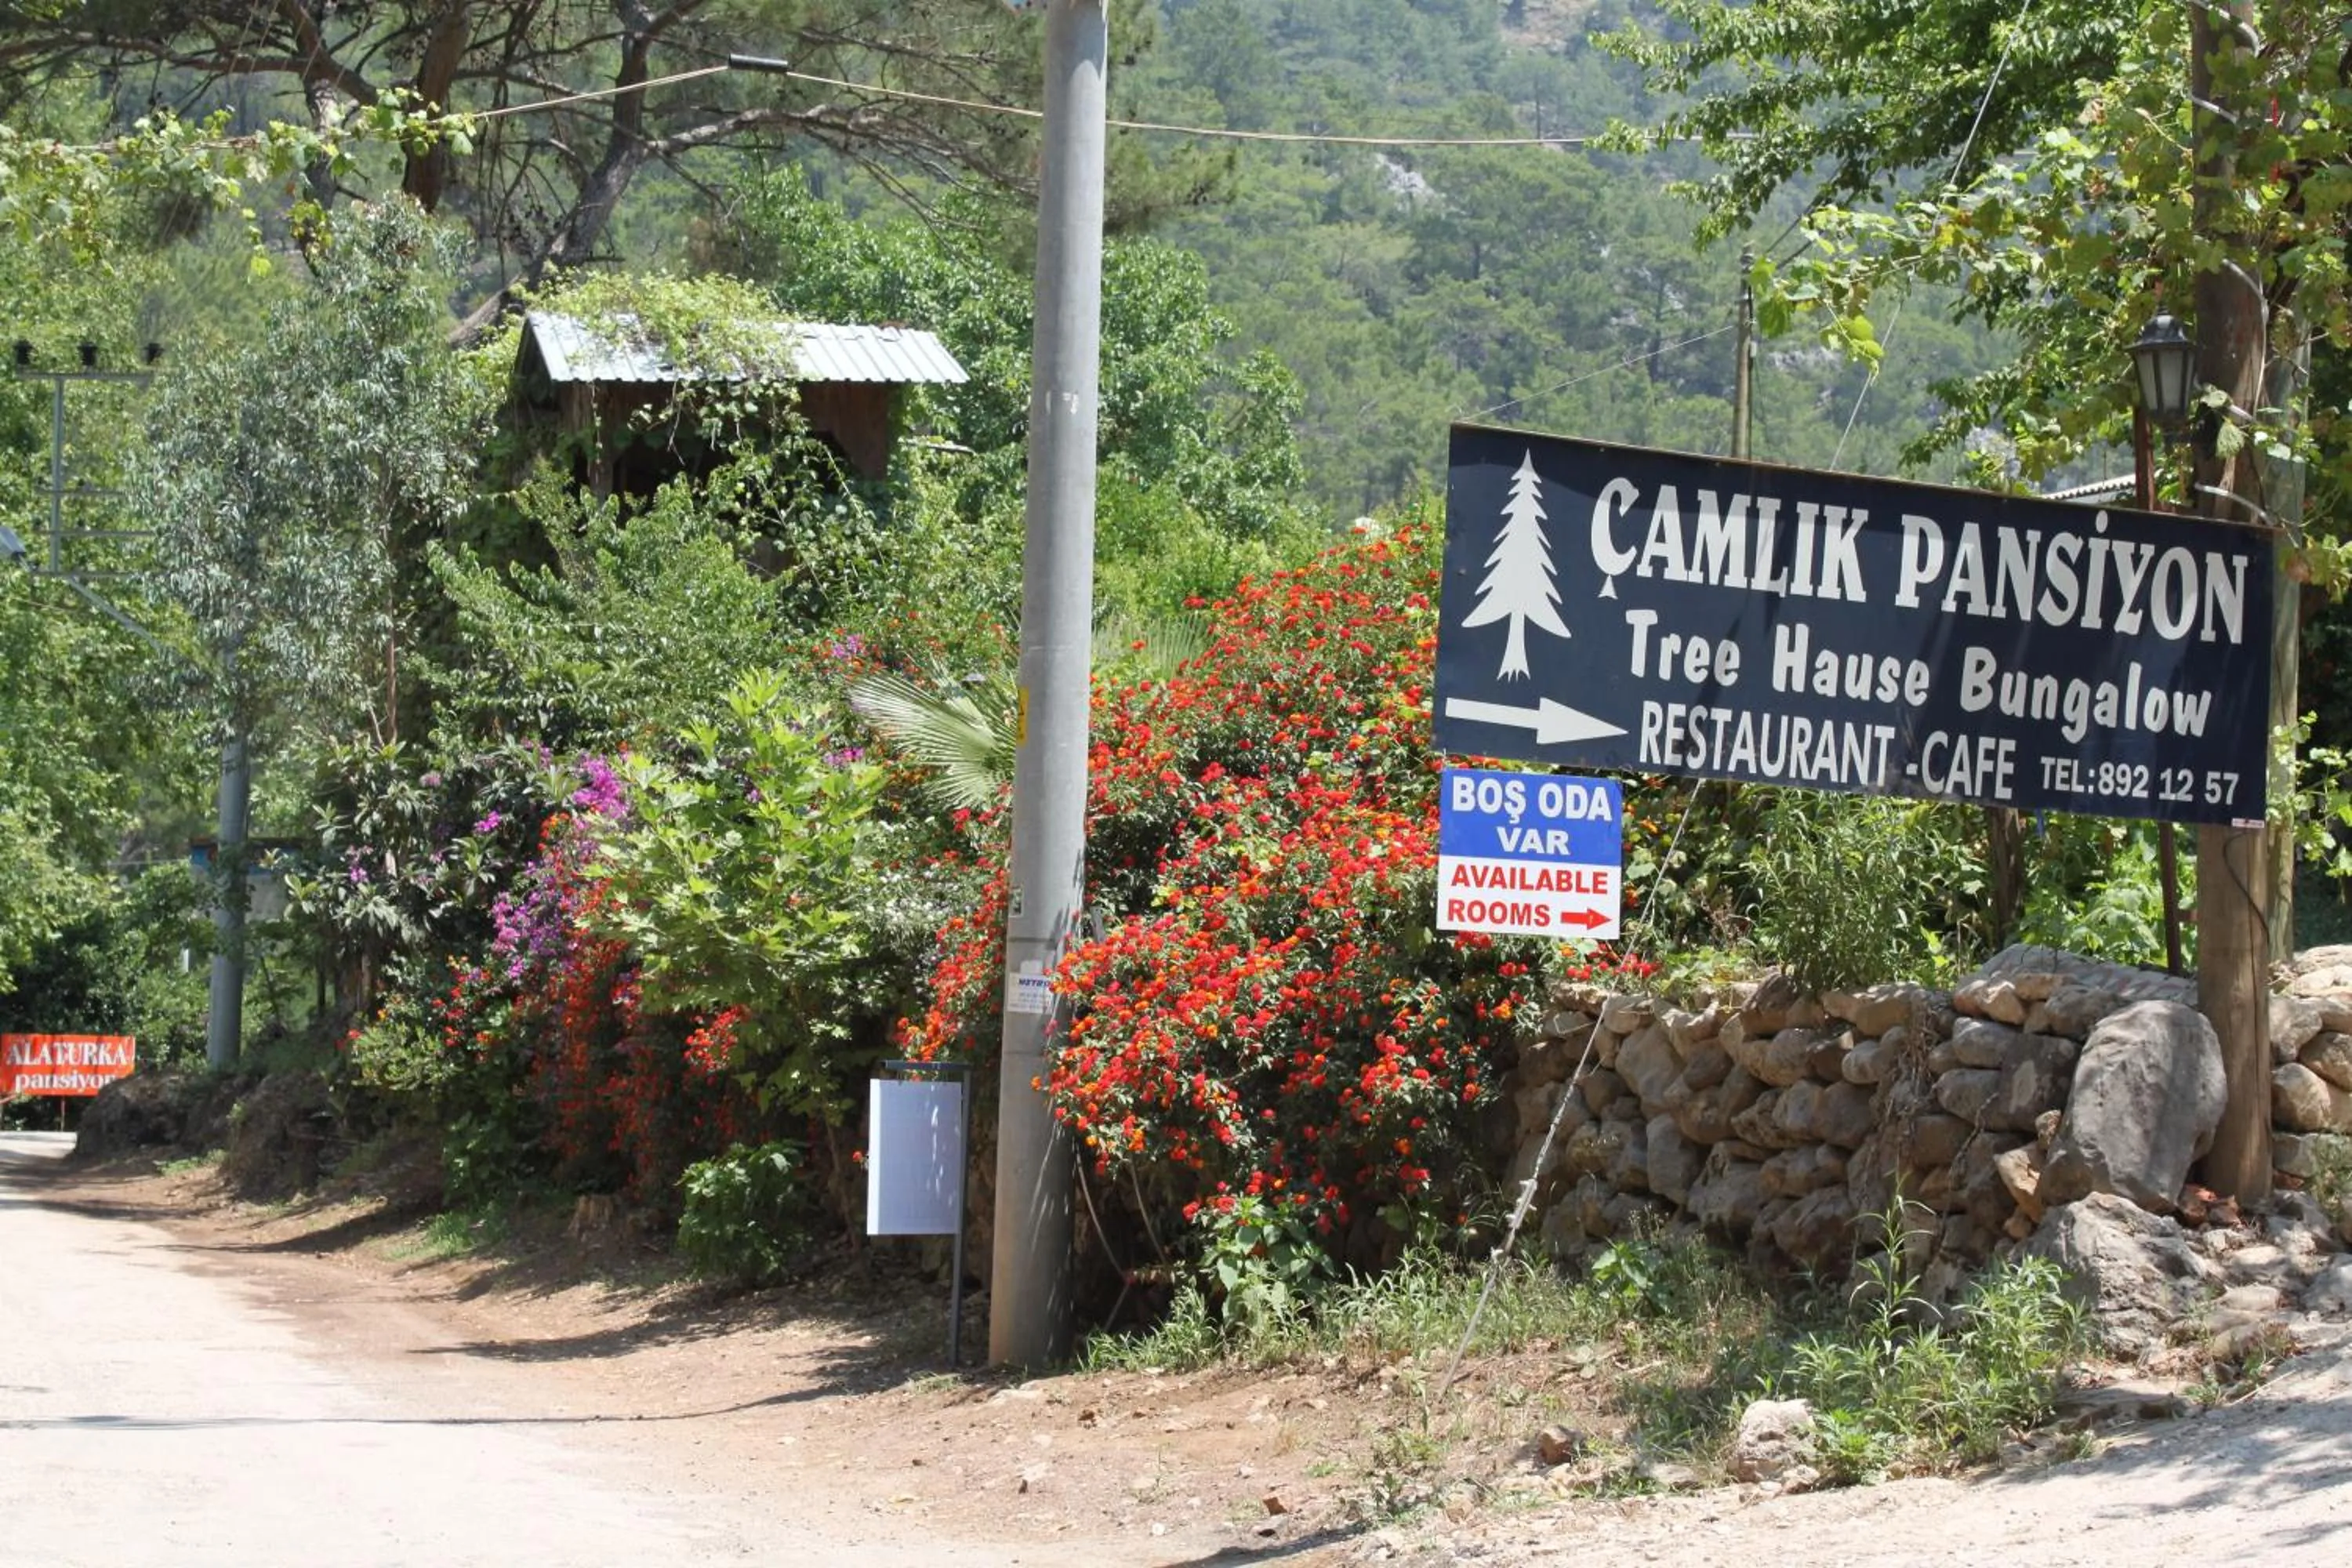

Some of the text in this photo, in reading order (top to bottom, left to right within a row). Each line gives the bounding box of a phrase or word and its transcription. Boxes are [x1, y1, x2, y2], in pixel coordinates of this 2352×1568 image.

[1590, 477, 2248, 644] ÇAMLIK PANSİYON
[1625, 609, 2212, 743] Tree Hause Bungalow
[1639, 699, 1895, 787] RESTAURANT
[2158, 767, 2194, 803] 12
[2204, 771, 2240, 805] 57
[1452, 776, 1613, 824] BOŞ ODA
[1497, 826, 1570, 855] VAR
[1450, 863, 1608, 895] AVAILABLE
[1447, 898, 1551, 927] ROOMS
[5, 1041, 128, 1065] ALATURKA
